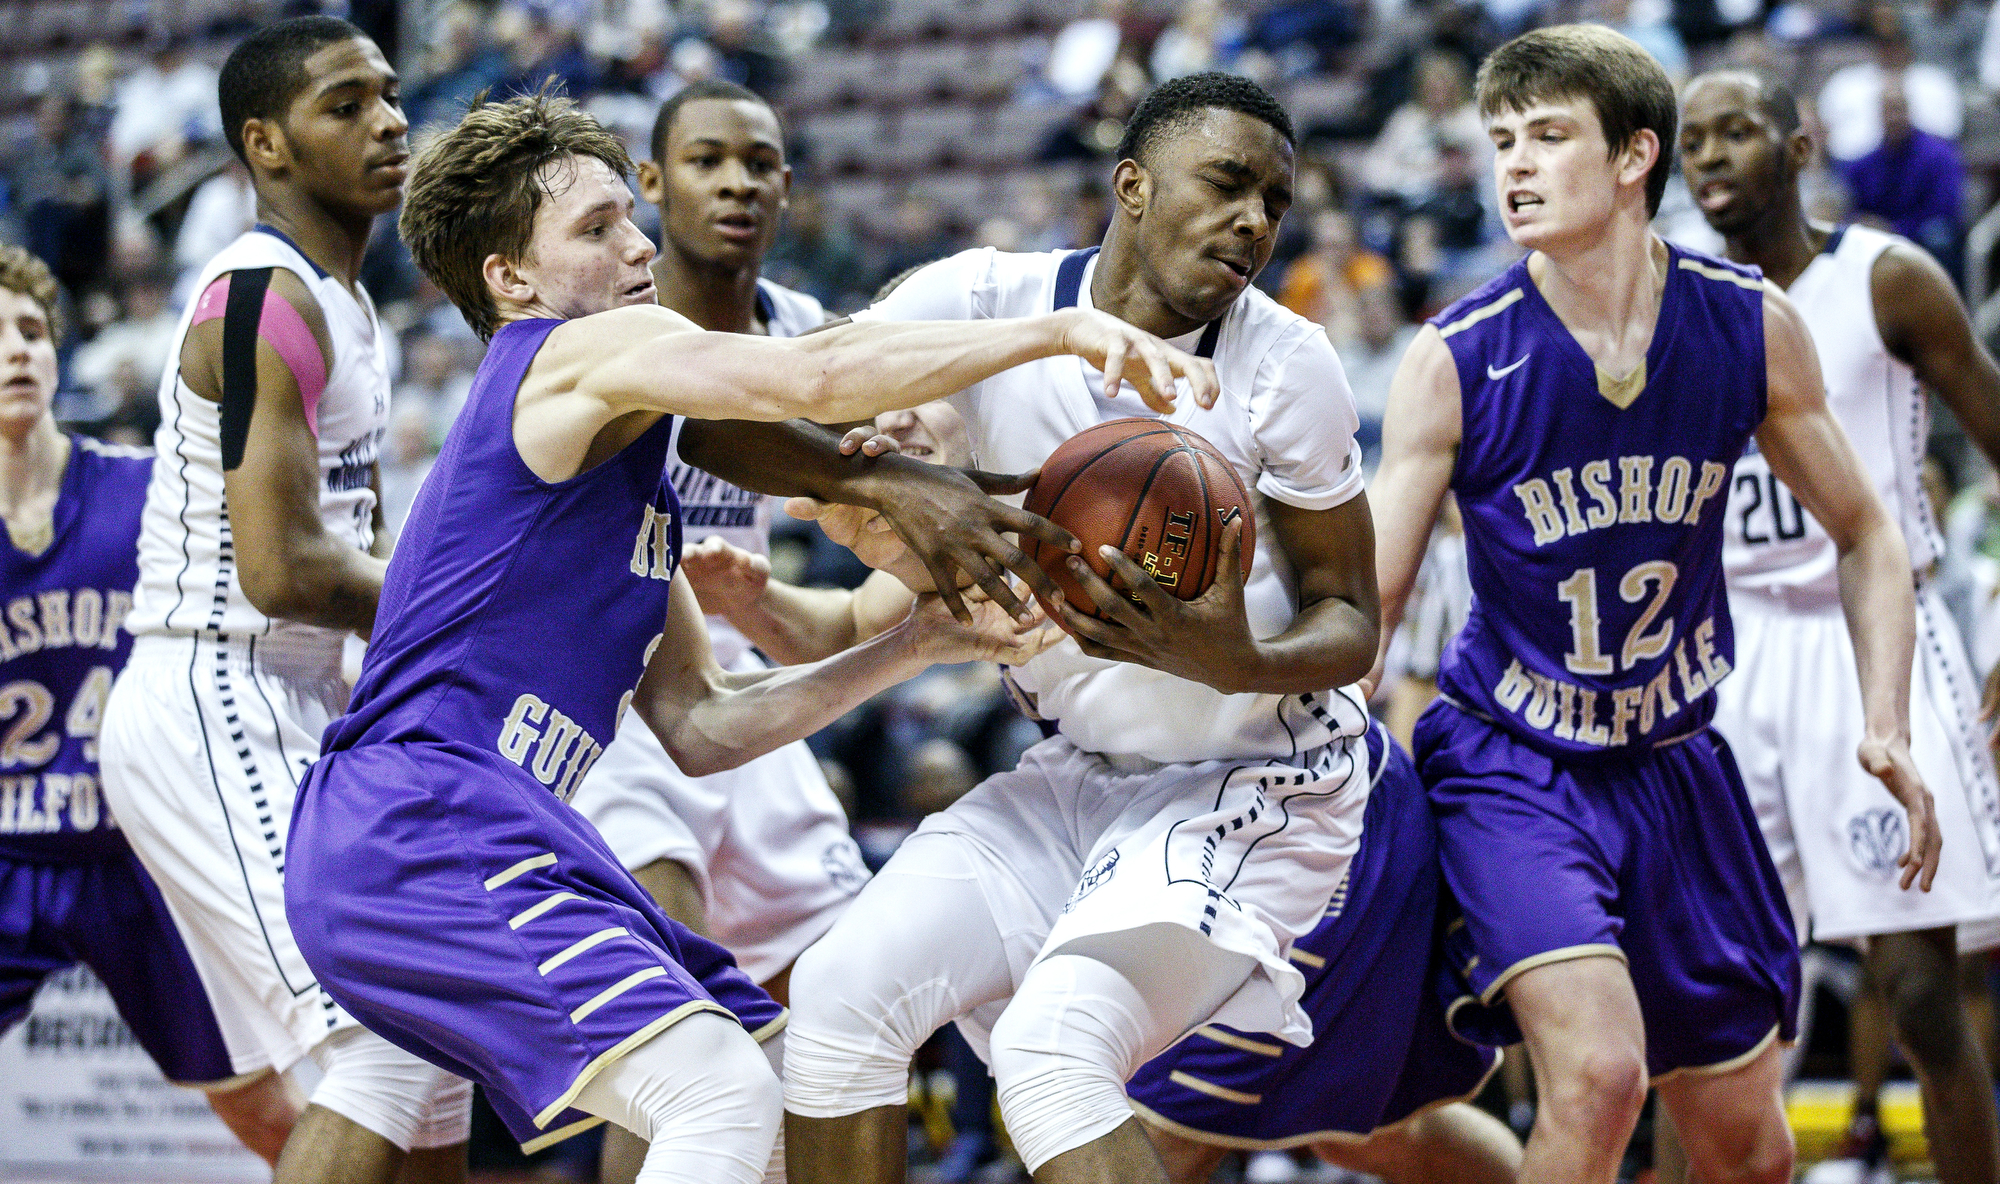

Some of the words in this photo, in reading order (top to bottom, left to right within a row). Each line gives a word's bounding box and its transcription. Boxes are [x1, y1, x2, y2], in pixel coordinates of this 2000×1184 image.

[1513, 455, 1726, 547] BISHOP
[1736, 473, 1806, 545] 20
[1558, 559, 1679, 676] 12
[0, 666, 114, 768] 24
